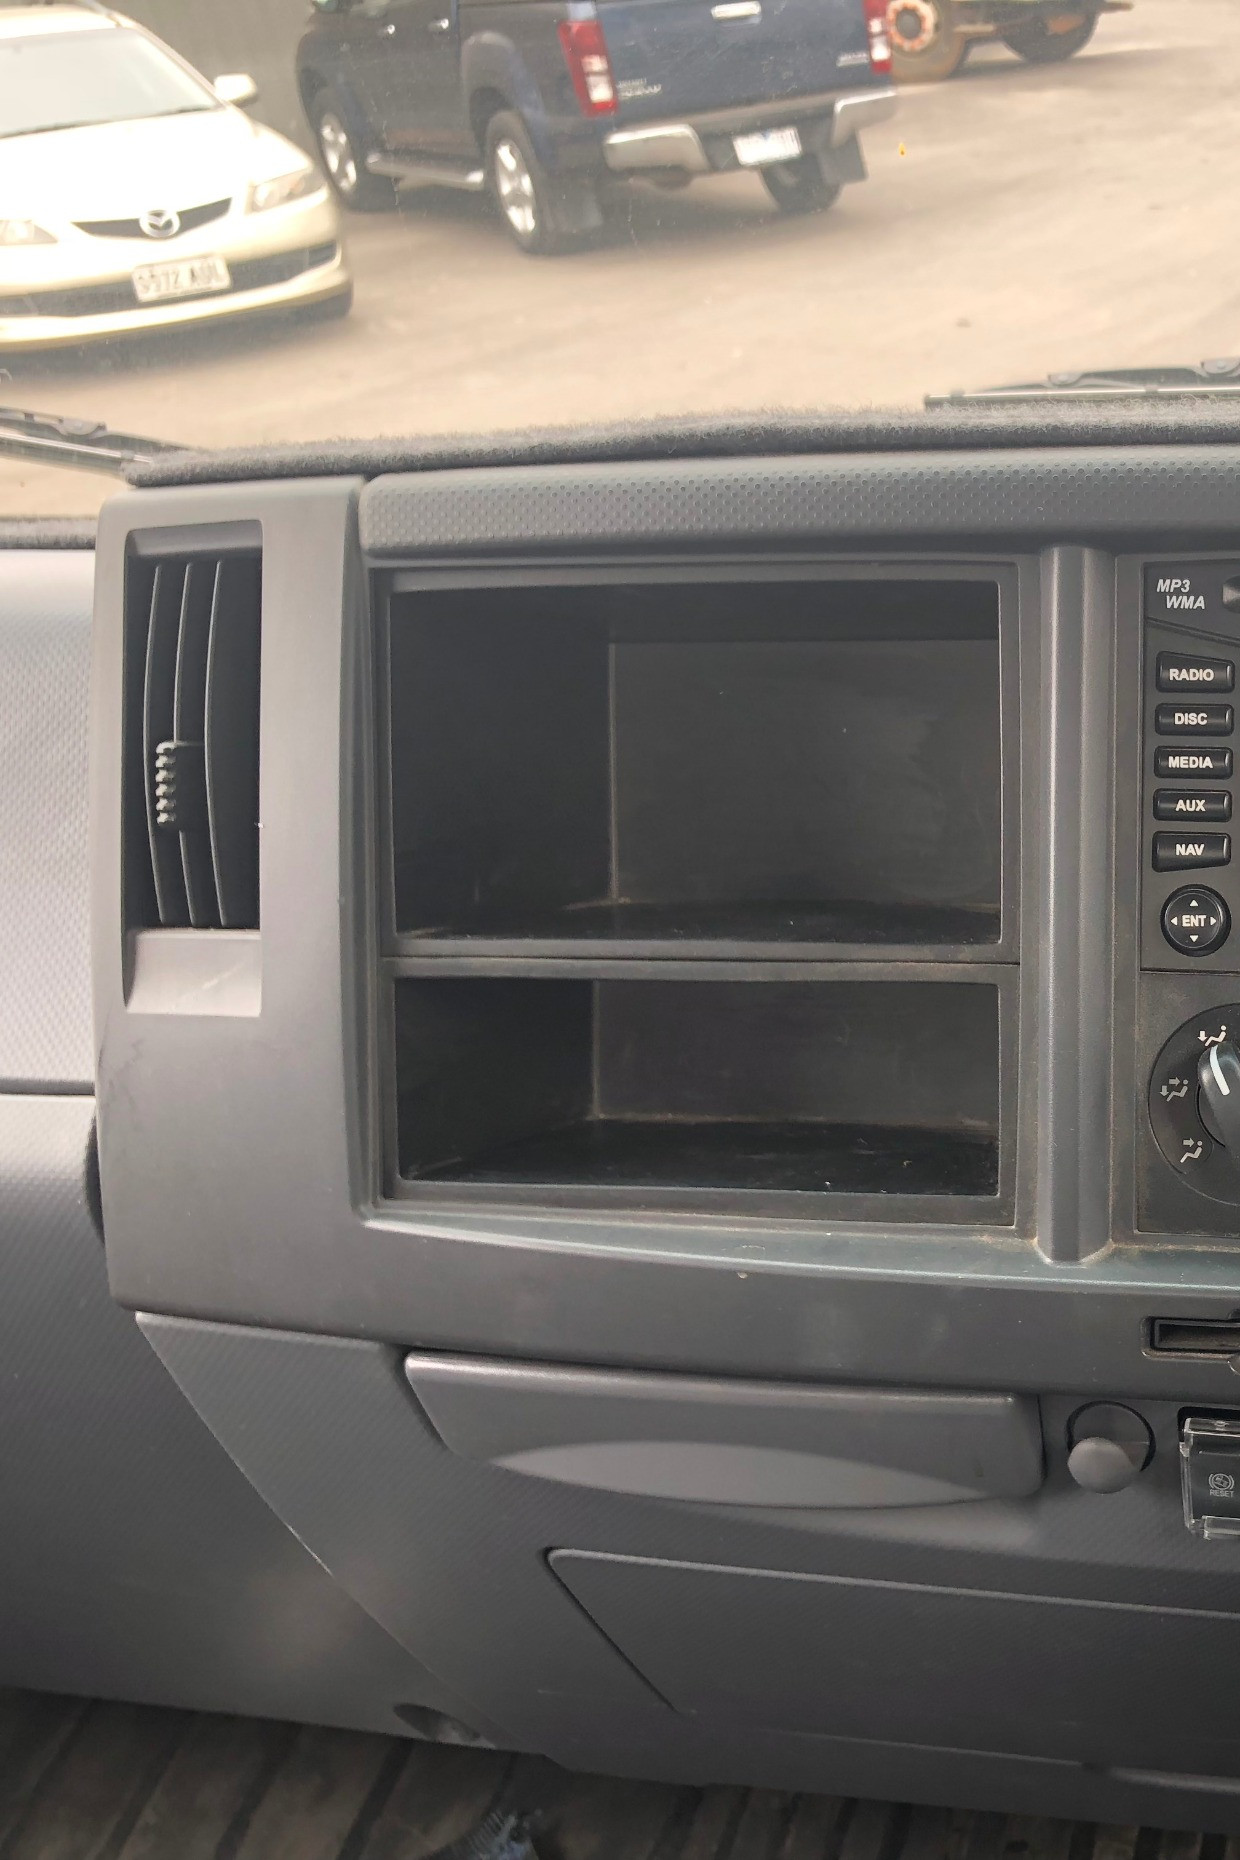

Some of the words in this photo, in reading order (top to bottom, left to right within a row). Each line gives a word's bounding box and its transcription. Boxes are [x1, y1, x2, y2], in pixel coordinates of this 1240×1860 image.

[1156, 579, 1190, 593] MP3
[1166, 595, 1205, 609] WMA
[1169, 668, 1215, 681] RADIO
[1174, 713, 1208, 725] DISC
[1168, 756, 1213, 769] MEDIA
[1175, 800, 1206, 812] AUX
[1175, 844, 1205, 856] NAV
[1181, 914, 1207, 927] ENT
[1209, 1489, 1235, 1498] RESET
